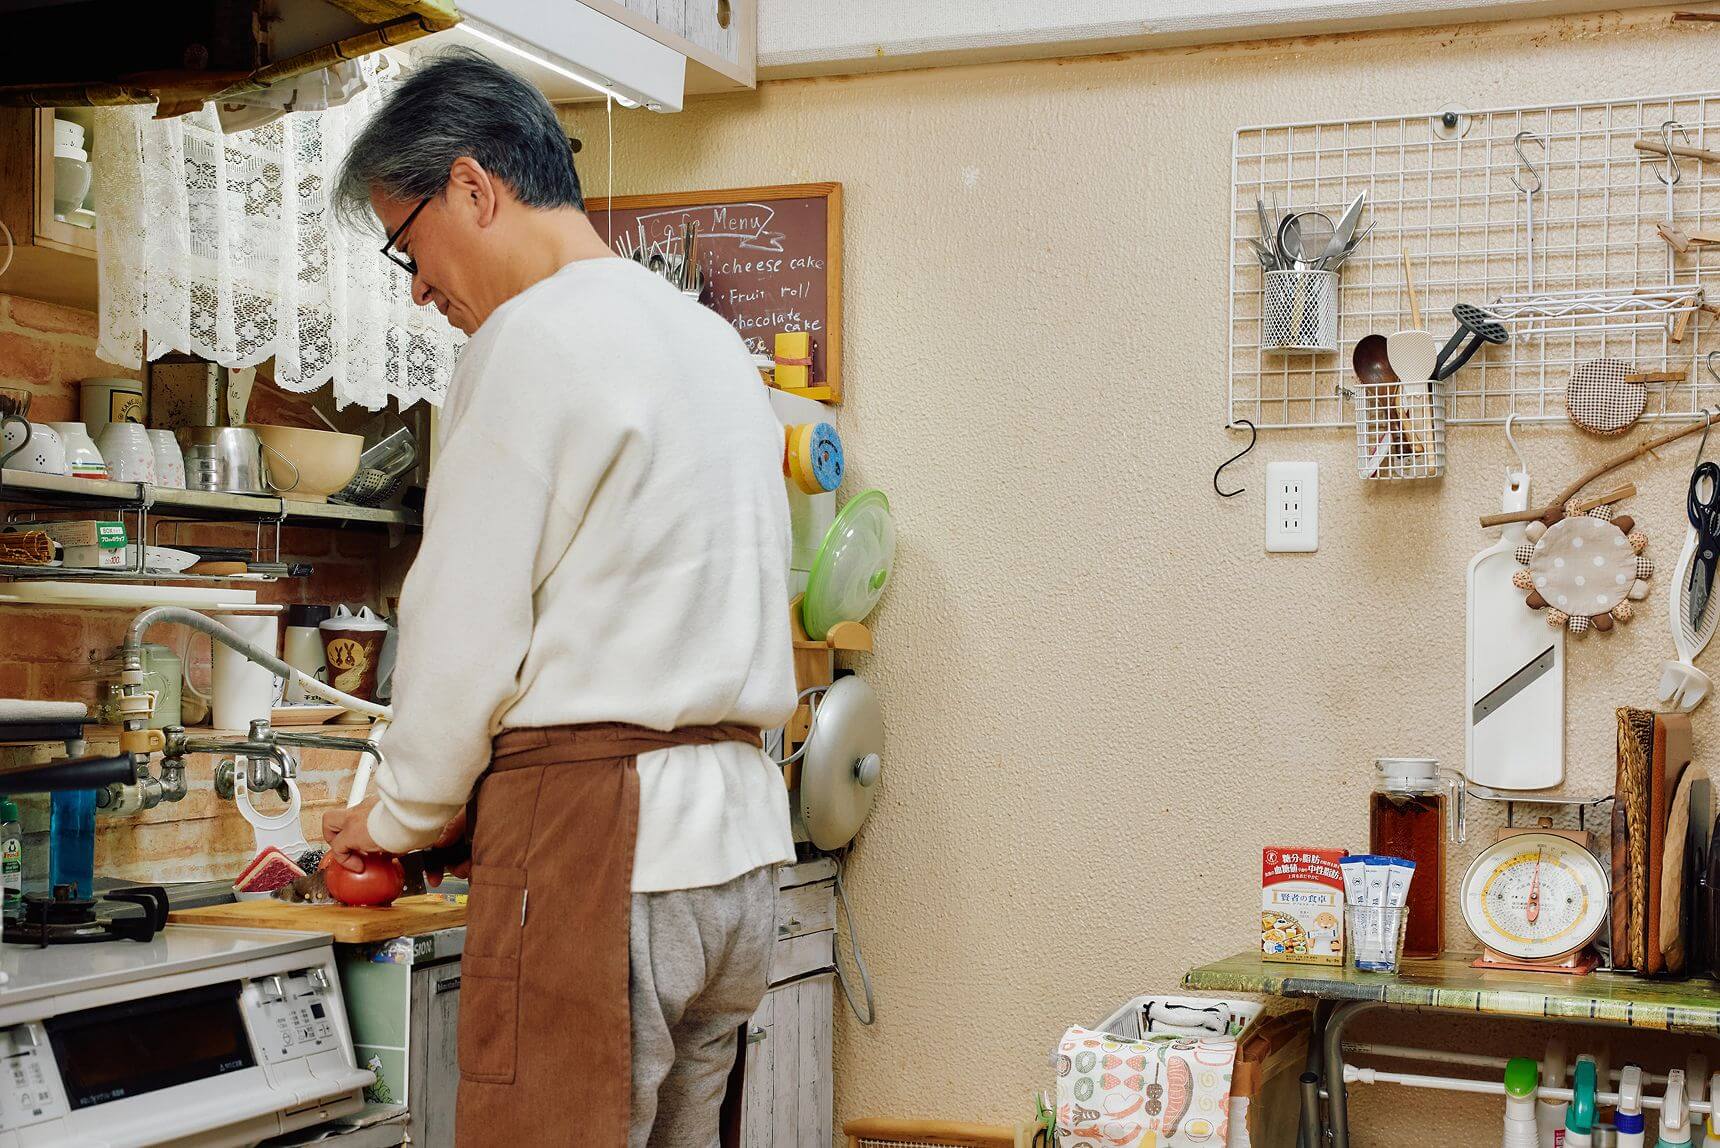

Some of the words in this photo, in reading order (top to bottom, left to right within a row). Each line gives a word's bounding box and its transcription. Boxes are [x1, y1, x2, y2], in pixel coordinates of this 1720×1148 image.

[711, 207, 761, 232] Menu
[722, 258, 783, 274] cheese
[790, 256, 824, 270] cake
[729, 288, 766, 305] Fruit
[781, 281, 810, 299] roll
[731, 307, 801, 330] chocolate
[784, 319, 822, 333] cake
